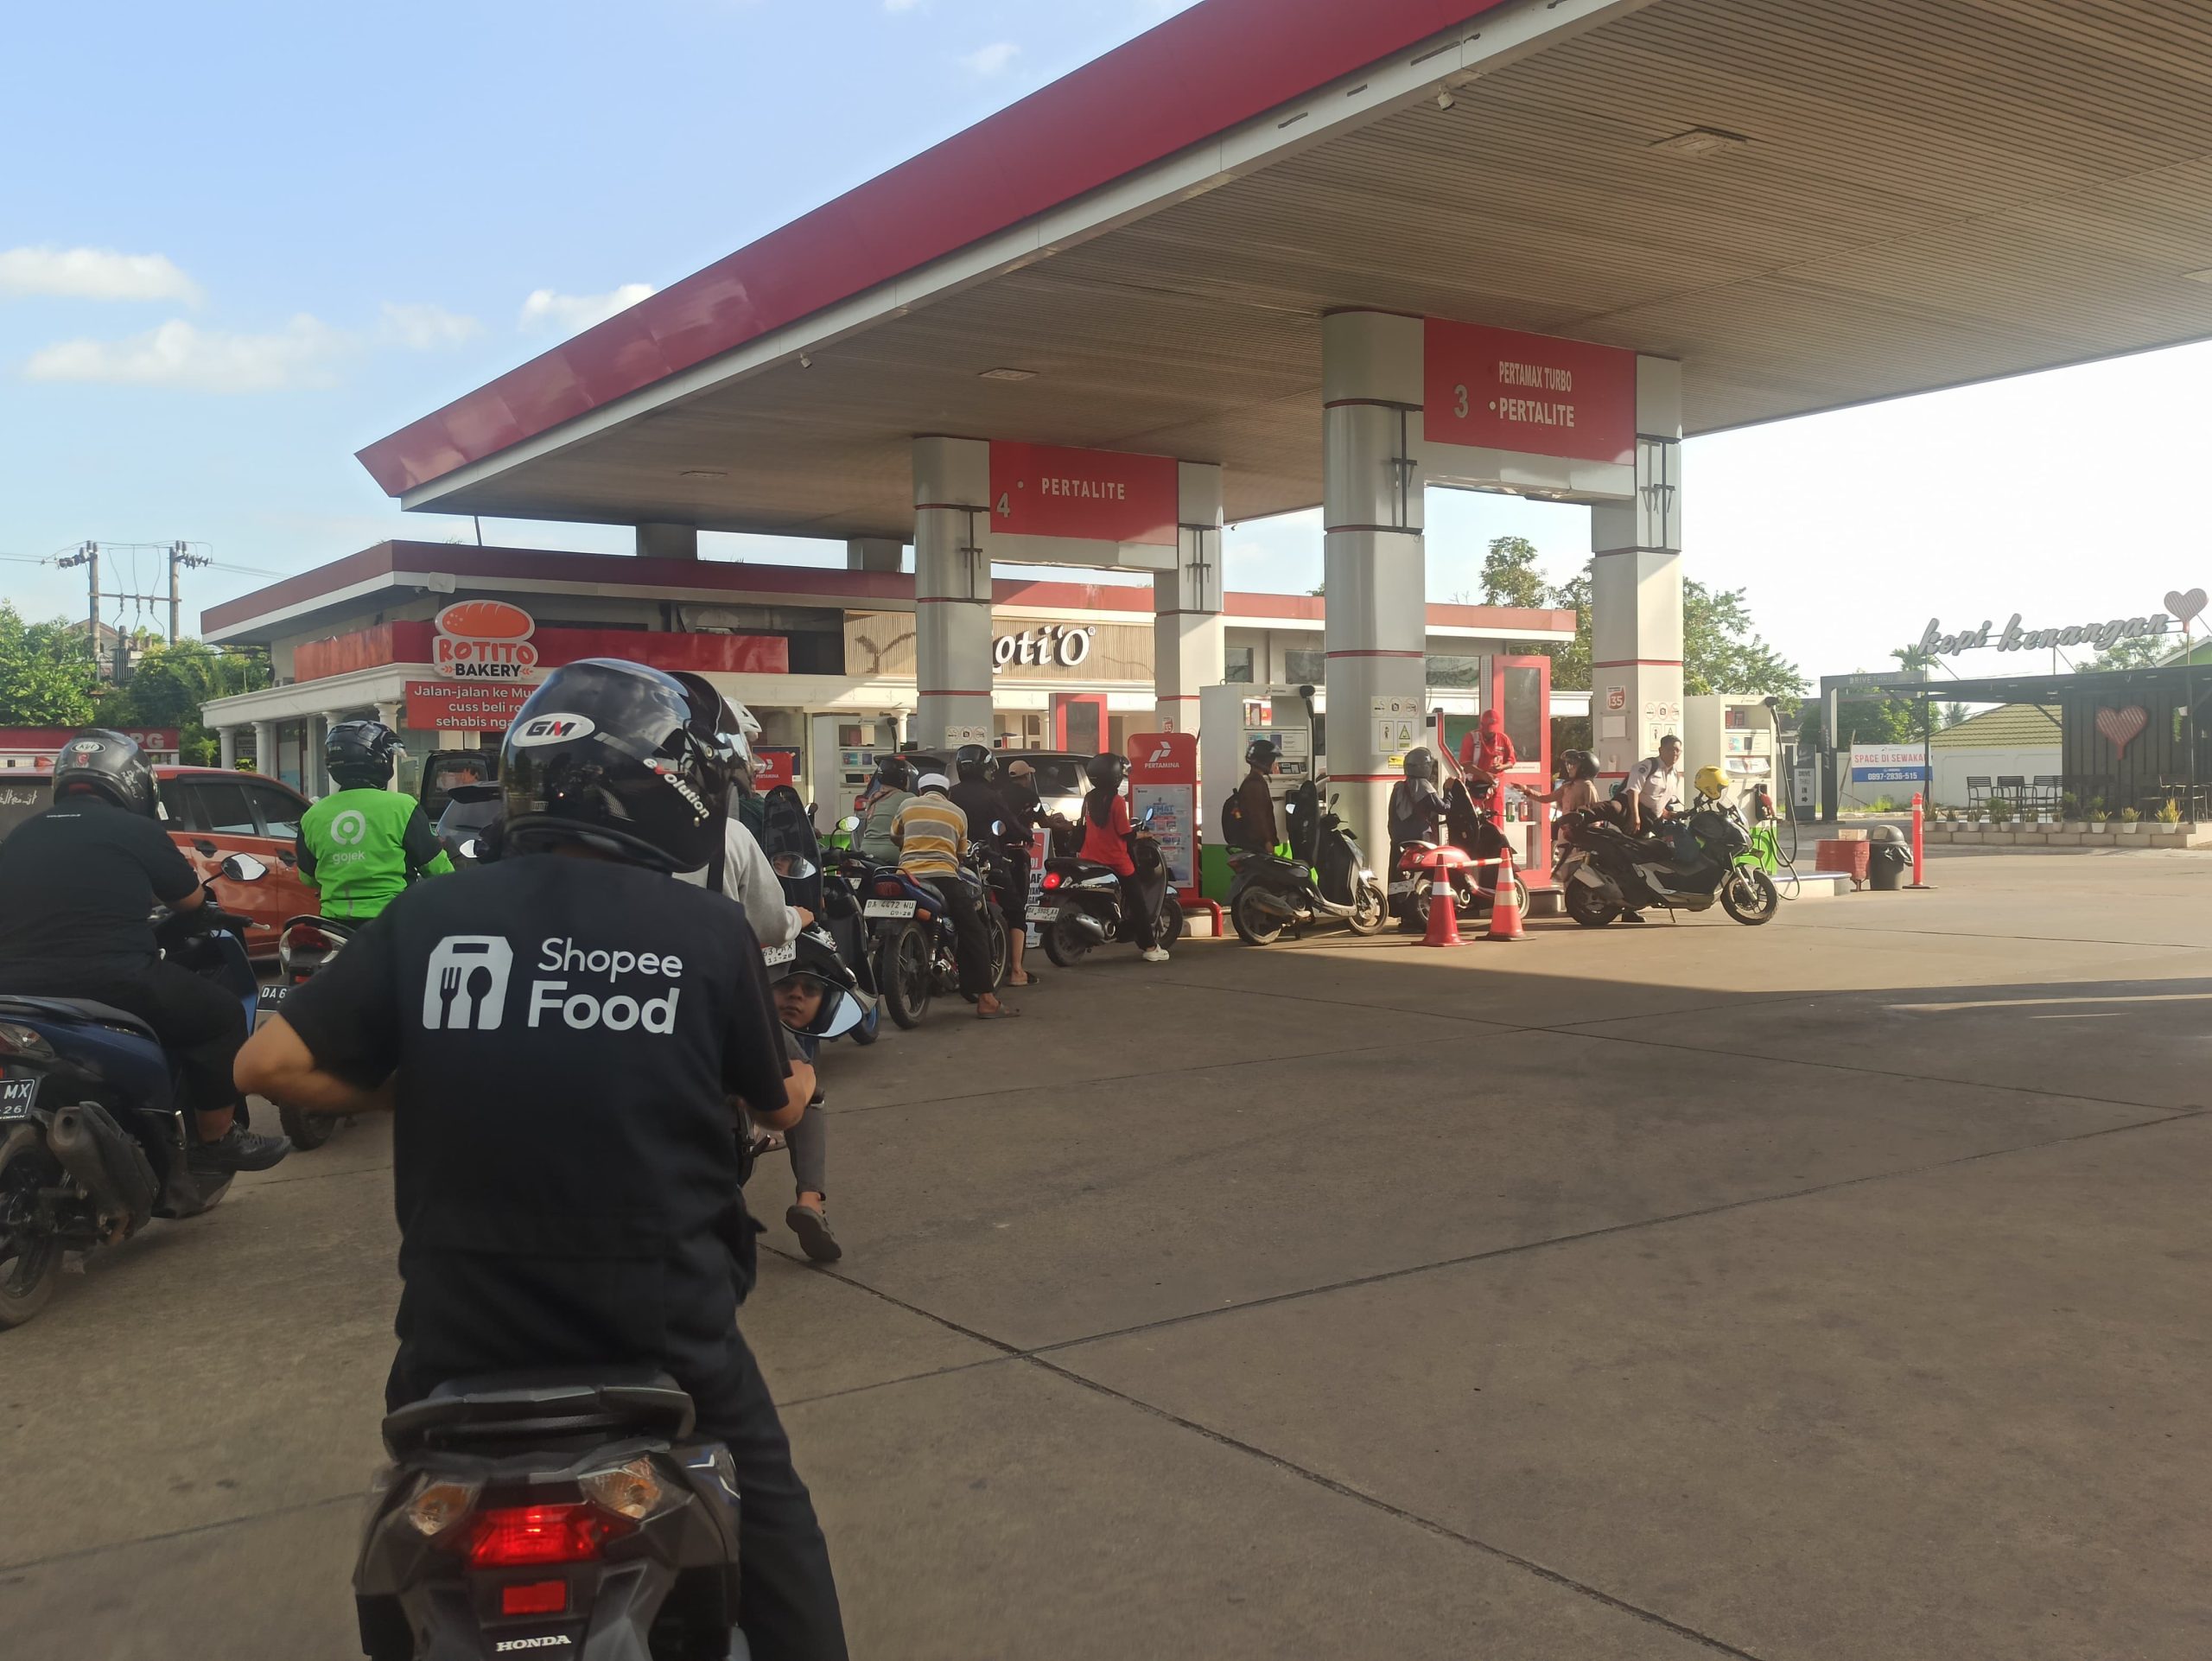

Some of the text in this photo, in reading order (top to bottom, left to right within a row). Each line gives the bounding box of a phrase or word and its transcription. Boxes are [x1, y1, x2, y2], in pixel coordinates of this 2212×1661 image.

[1499, 361, 1572, 392] PERTAMAX TURBO
[1453, 385, 1469, 418] 3
[1499, 398, 1574, 427] PERTALITE
[1041, 478, 1125, 500] PERTALITE
[996, 493, 1010, 518] 4
[1917, 613, 2170, 656] kopi kenangan
[439, 639, 534, 665] ROTITO
[993, 624, 1090, 673] oti'O
[455, 663, 522, 677] BAKERY
[1849, 676, 1872, 684] DRIVE
[414, 685, 489, 698] Jalan-jalan
[493, 686, 508, 697] ke
[448, 703, 479, 712] cuss
[482, 702, 505, 713] beli
[435, 716, 486, 727] sehabis
[525, 721, 576, 736] GM
[1854, 754, 1879, 763] SPACE
[333, 850, 365, 864] gojek
[537, 937, 683, 983] Shopee
[262, 987, 276, 998] DA
[528, 980, 681, 1034] Food
[3, 1083, 31, 1099] MX
[496, 1635, 572, 1651] HONDA
